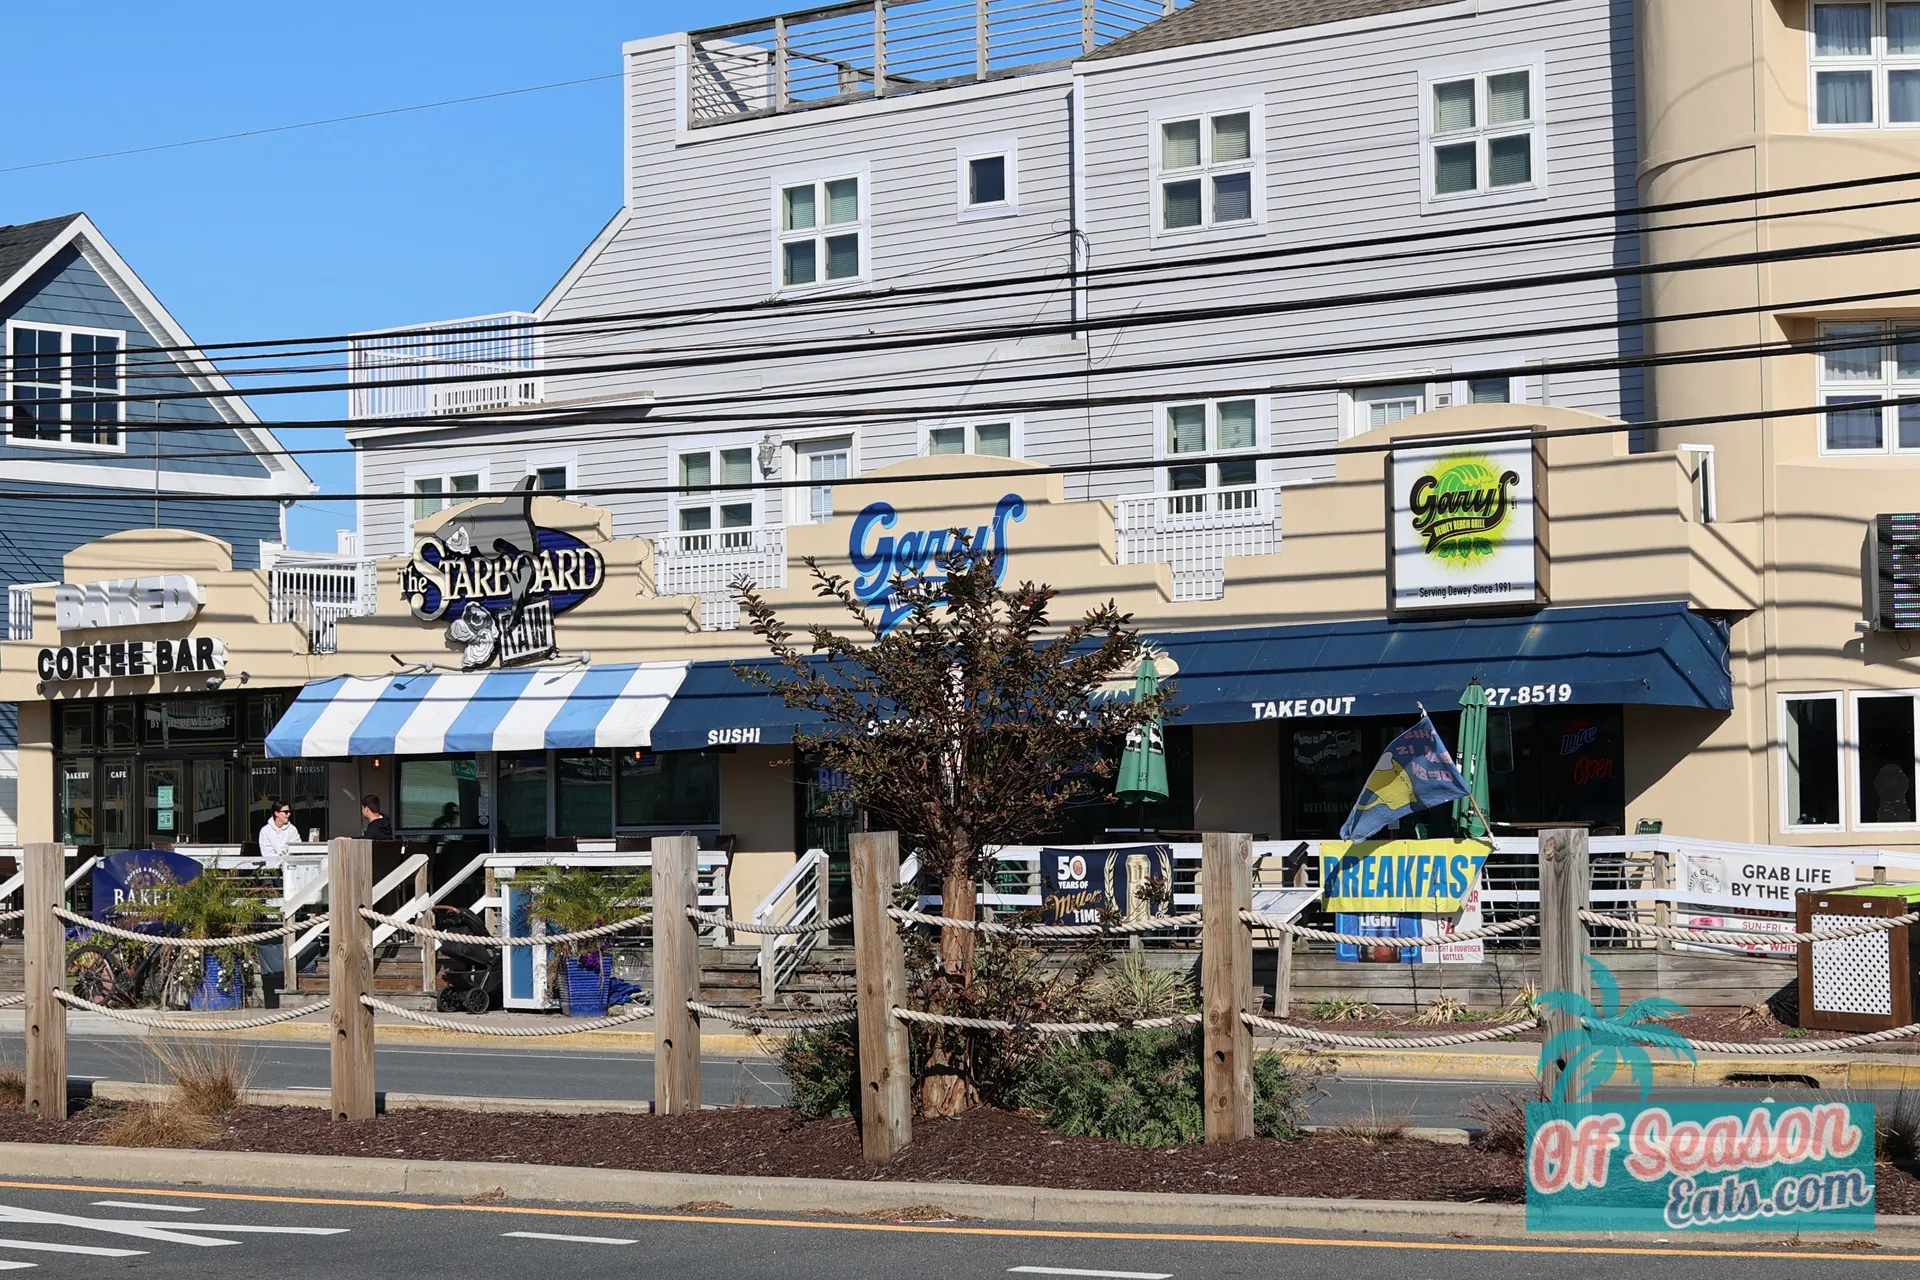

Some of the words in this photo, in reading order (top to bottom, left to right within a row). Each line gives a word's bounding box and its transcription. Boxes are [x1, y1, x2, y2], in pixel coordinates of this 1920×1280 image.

[1410, 470, 1519, 531] Gary's
[1434, 522, 1454, 537] DEWEY
[1454, 519, 1471, 532] BEACH
[1471, 518, 1486, 529] GRILL
[397, 567, 427, 594] The
[1419, 586, 1446, 598] Serving
[1448, 585, 1471, 597] Dewey
[1473, 583, 1493, 594] Since
[1494, 582, 1511, 592] 1991
[56, 574, 200, 630] BAKED
[500, 601, 553, 660] RAW
[37, 641, 150, 682] COFFEE
[155, 636, 218, 675] BAR
[1251, 699, 1307, 719] TAKE
[1309, 696, 1356, 716] OUT
[150, 720, 160, 729] BY
[210, 716, 232, 726] POST
[707, 727, 761, 745] SUSHI
[65, 771, 89, 779] BAKERY
[252, 766, 277, 775] BISTRO
[295, 765, 325, 774] FLORIST
[1573, 756, 1616, 785] Open
[124, 867, 142, 885] COFFEE
[1057, 855, 1087, 880] 50
[1742, 864, 1790, 881] GRAB
[1795, 868, 1831, 884] LIFE
[1058, 881, 1079, 889] YEARS
[1079, 881, 1089, 889] OF
[1731, 882, 1750, 897] BY
[1756, 885, 1790, 900] THE
[1742, 921, 1781, 932] SUN-FRI
